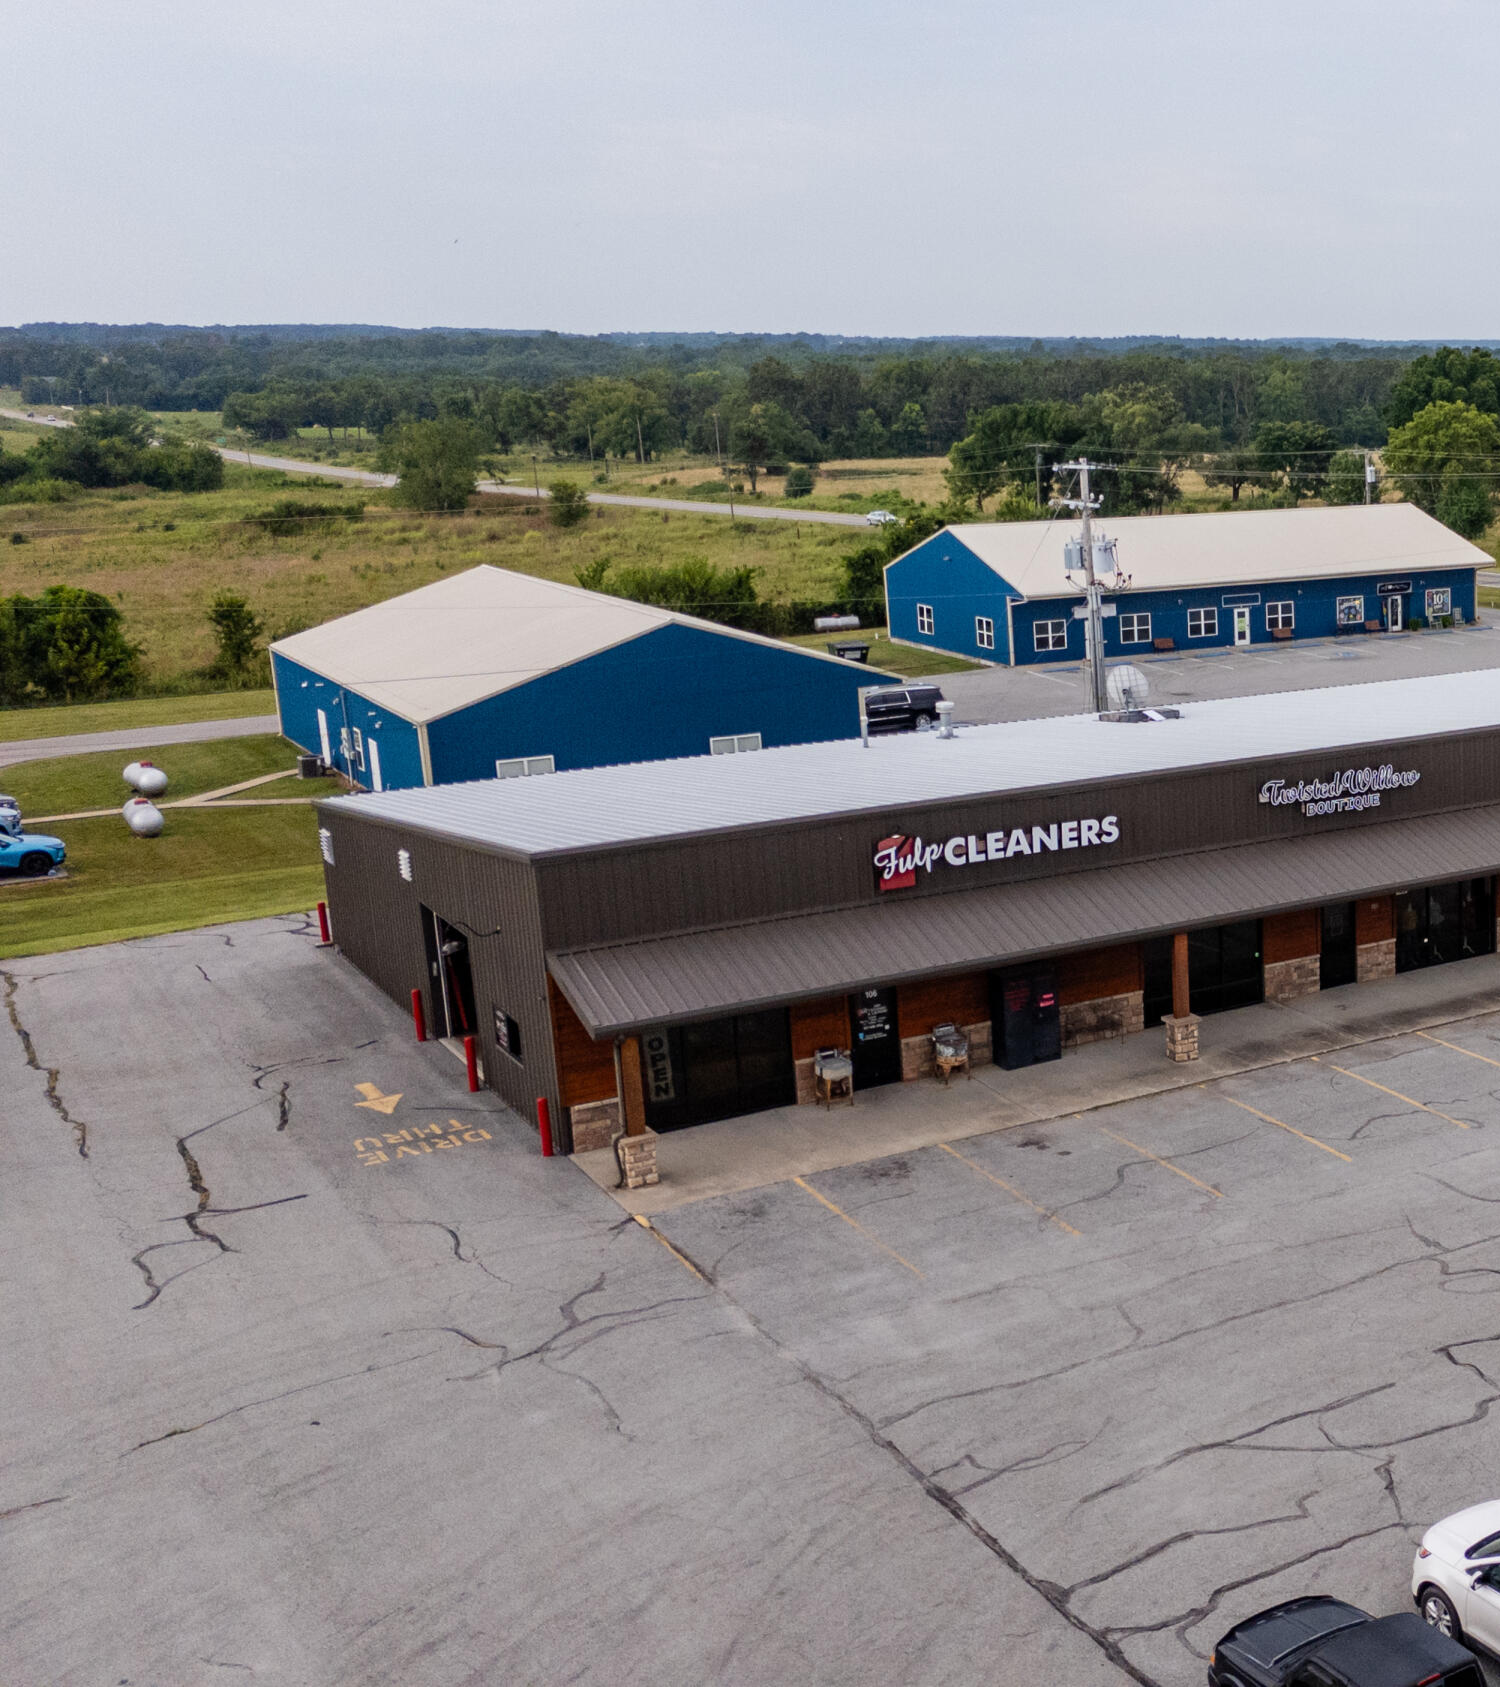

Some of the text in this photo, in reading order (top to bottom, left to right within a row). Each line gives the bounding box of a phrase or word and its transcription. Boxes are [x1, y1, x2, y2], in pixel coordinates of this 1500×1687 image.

[1261, 763, 1421, 806] Twisted Willow
[1306, 793, 1380, 817] BOUTIQUE
[873, 815, 1120, 880] Fulp CLEANERS
[648, 1036, 670, 1098] OPEN
[353, 1119, 472, 1152] THRU
[356, 1128, 493, 1167] DRIVE
